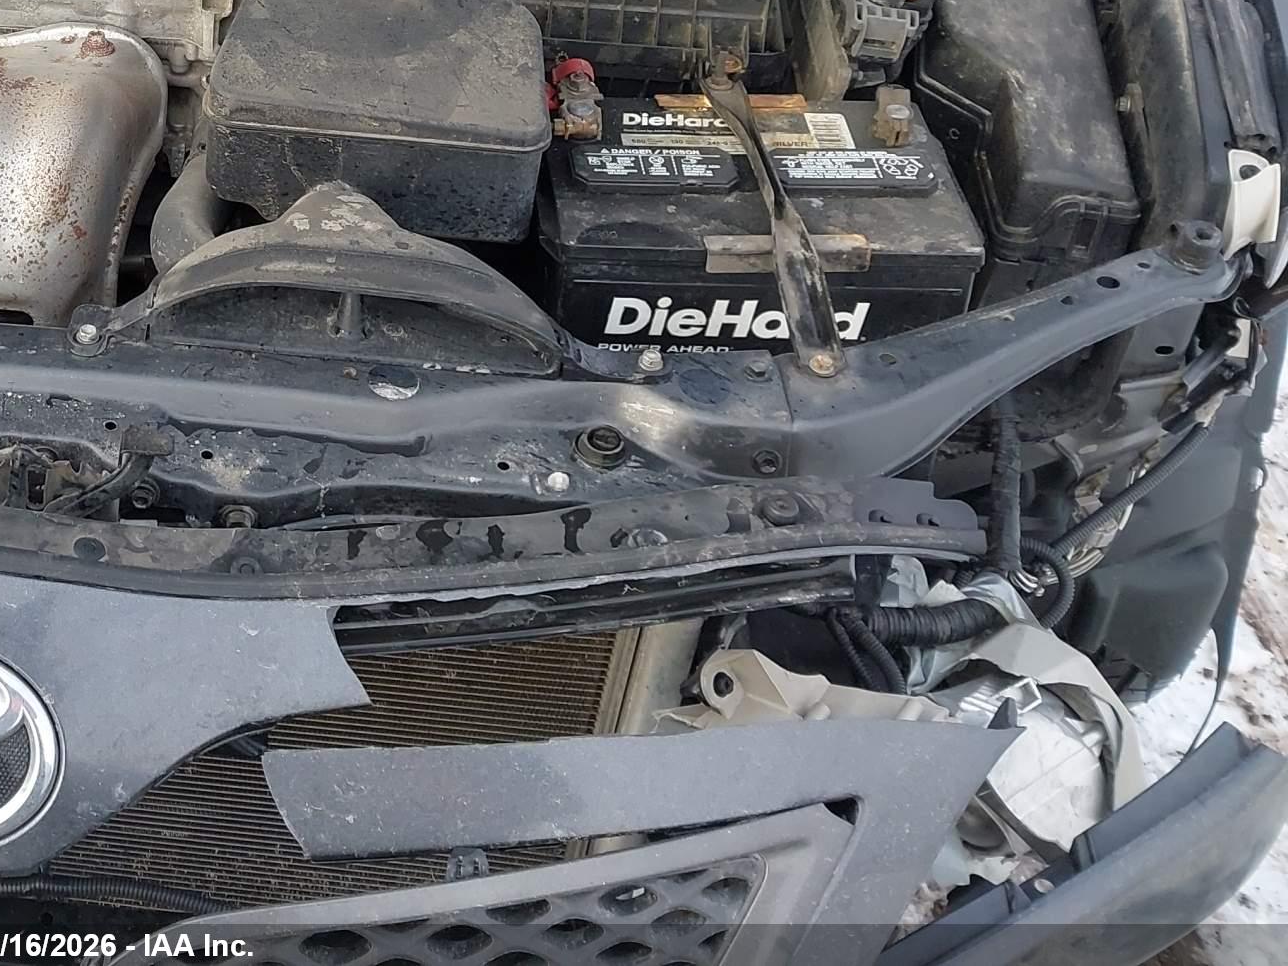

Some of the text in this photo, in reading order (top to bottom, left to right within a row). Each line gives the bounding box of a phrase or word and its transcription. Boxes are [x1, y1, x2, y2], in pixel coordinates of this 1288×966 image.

[662, 148, 700, 156] POISON
[604, 296, 871, 342] DieHad
[666, 345, 730, 354] AHEAD
